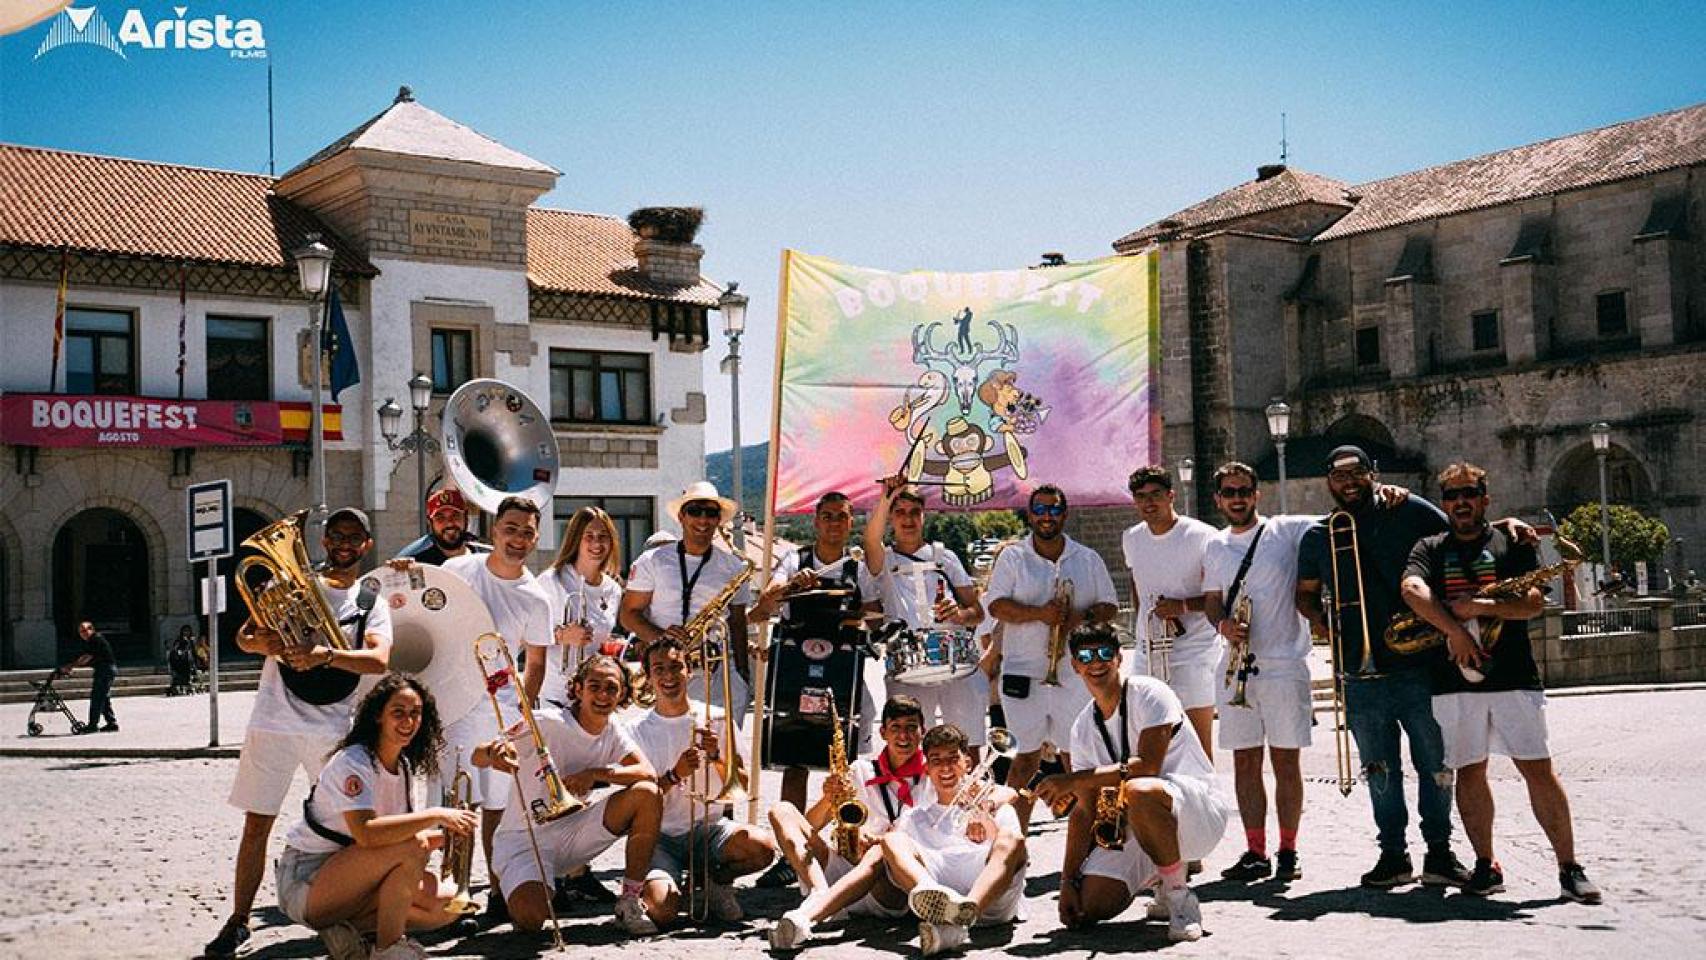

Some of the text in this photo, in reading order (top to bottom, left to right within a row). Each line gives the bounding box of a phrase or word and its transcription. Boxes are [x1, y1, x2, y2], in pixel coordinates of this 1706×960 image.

[834, 272, 1103, 318] BOQUEFEST
[31, 399, 198, 430] BOQUEFEST
[98, 431, 140, 443] AGOSTO
